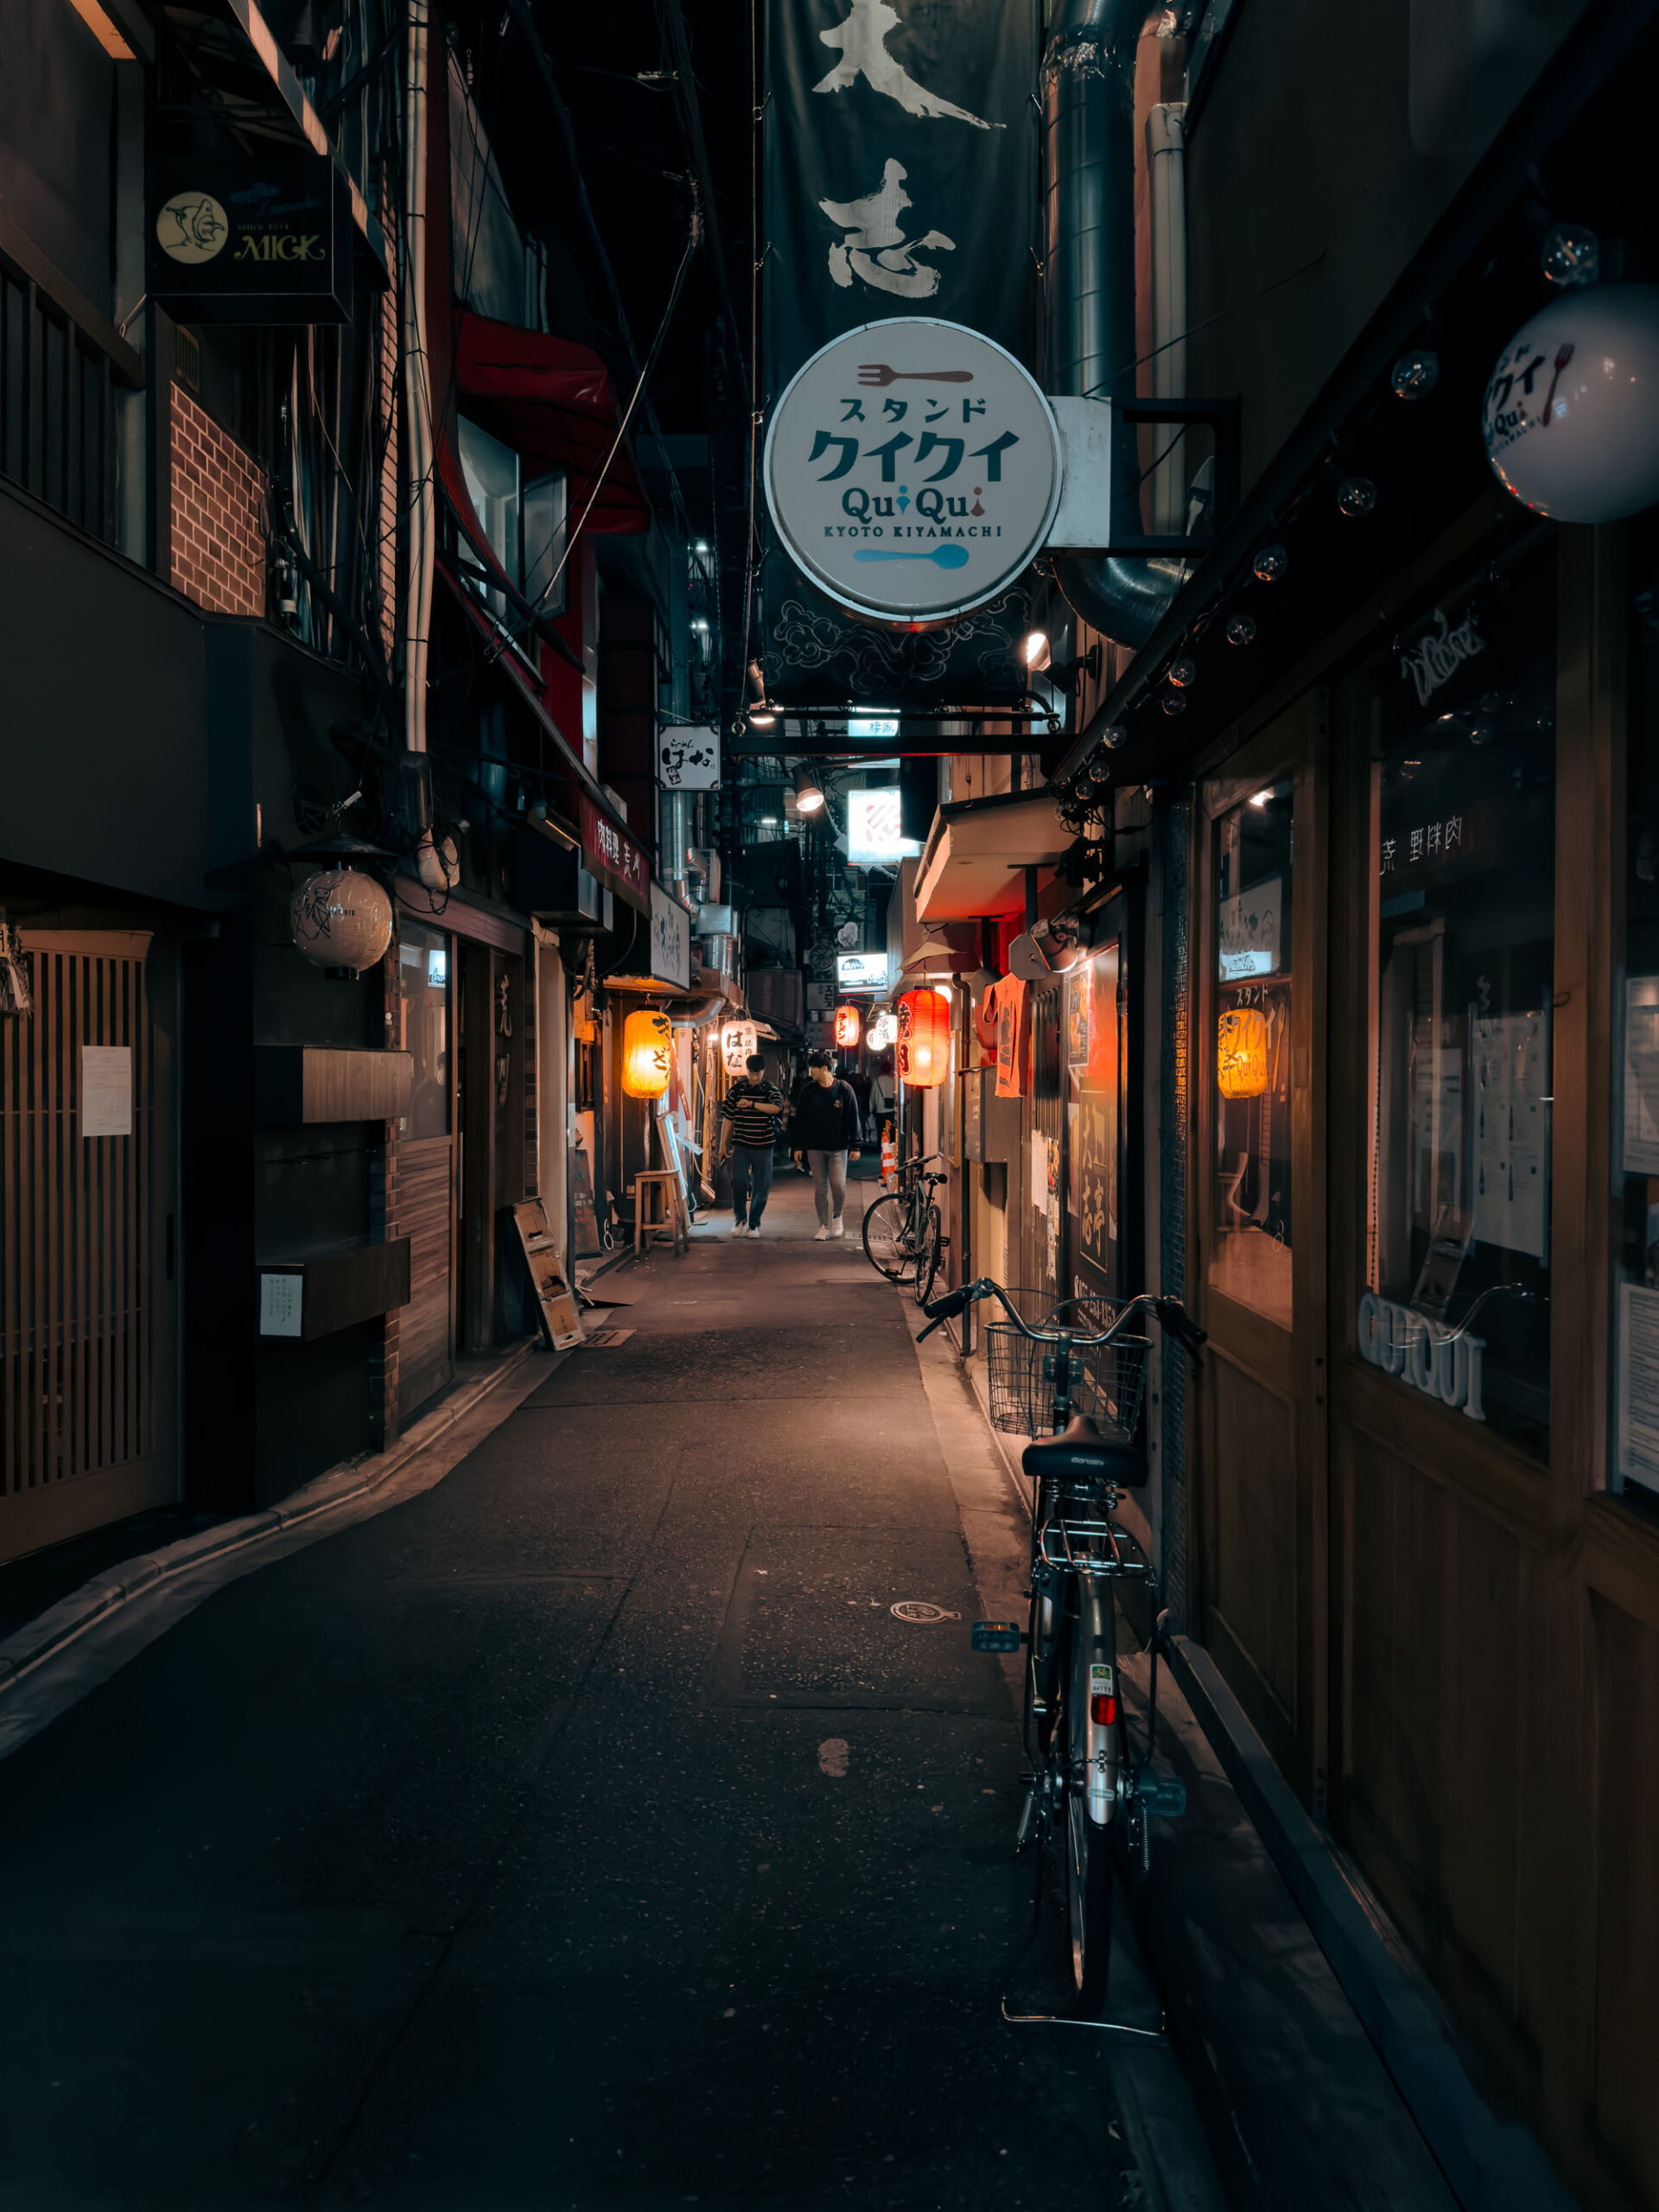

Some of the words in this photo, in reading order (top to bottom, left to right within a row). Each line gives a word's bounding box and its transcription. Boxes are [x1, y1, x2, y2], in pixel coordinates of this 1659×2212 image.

[232, 234, 326, 261] MICK
[840, 398, 987, 423] スタンド
[808, 430, 1020, 482] クイクイ
[842, 485, 985, 524] QuiQui
[823, 526, 884, 537] KYOTO
[893, 526, 1002, 537] KIYAMACHI
[661, 747, 714, 770] はな
[597, 818, 620, 865] 肉料理
[1236, 982, 1268, 1006] スタンド
[836, 1013, 847, 1040] ラーメン
[726, 1030, 744, 1068] はな
